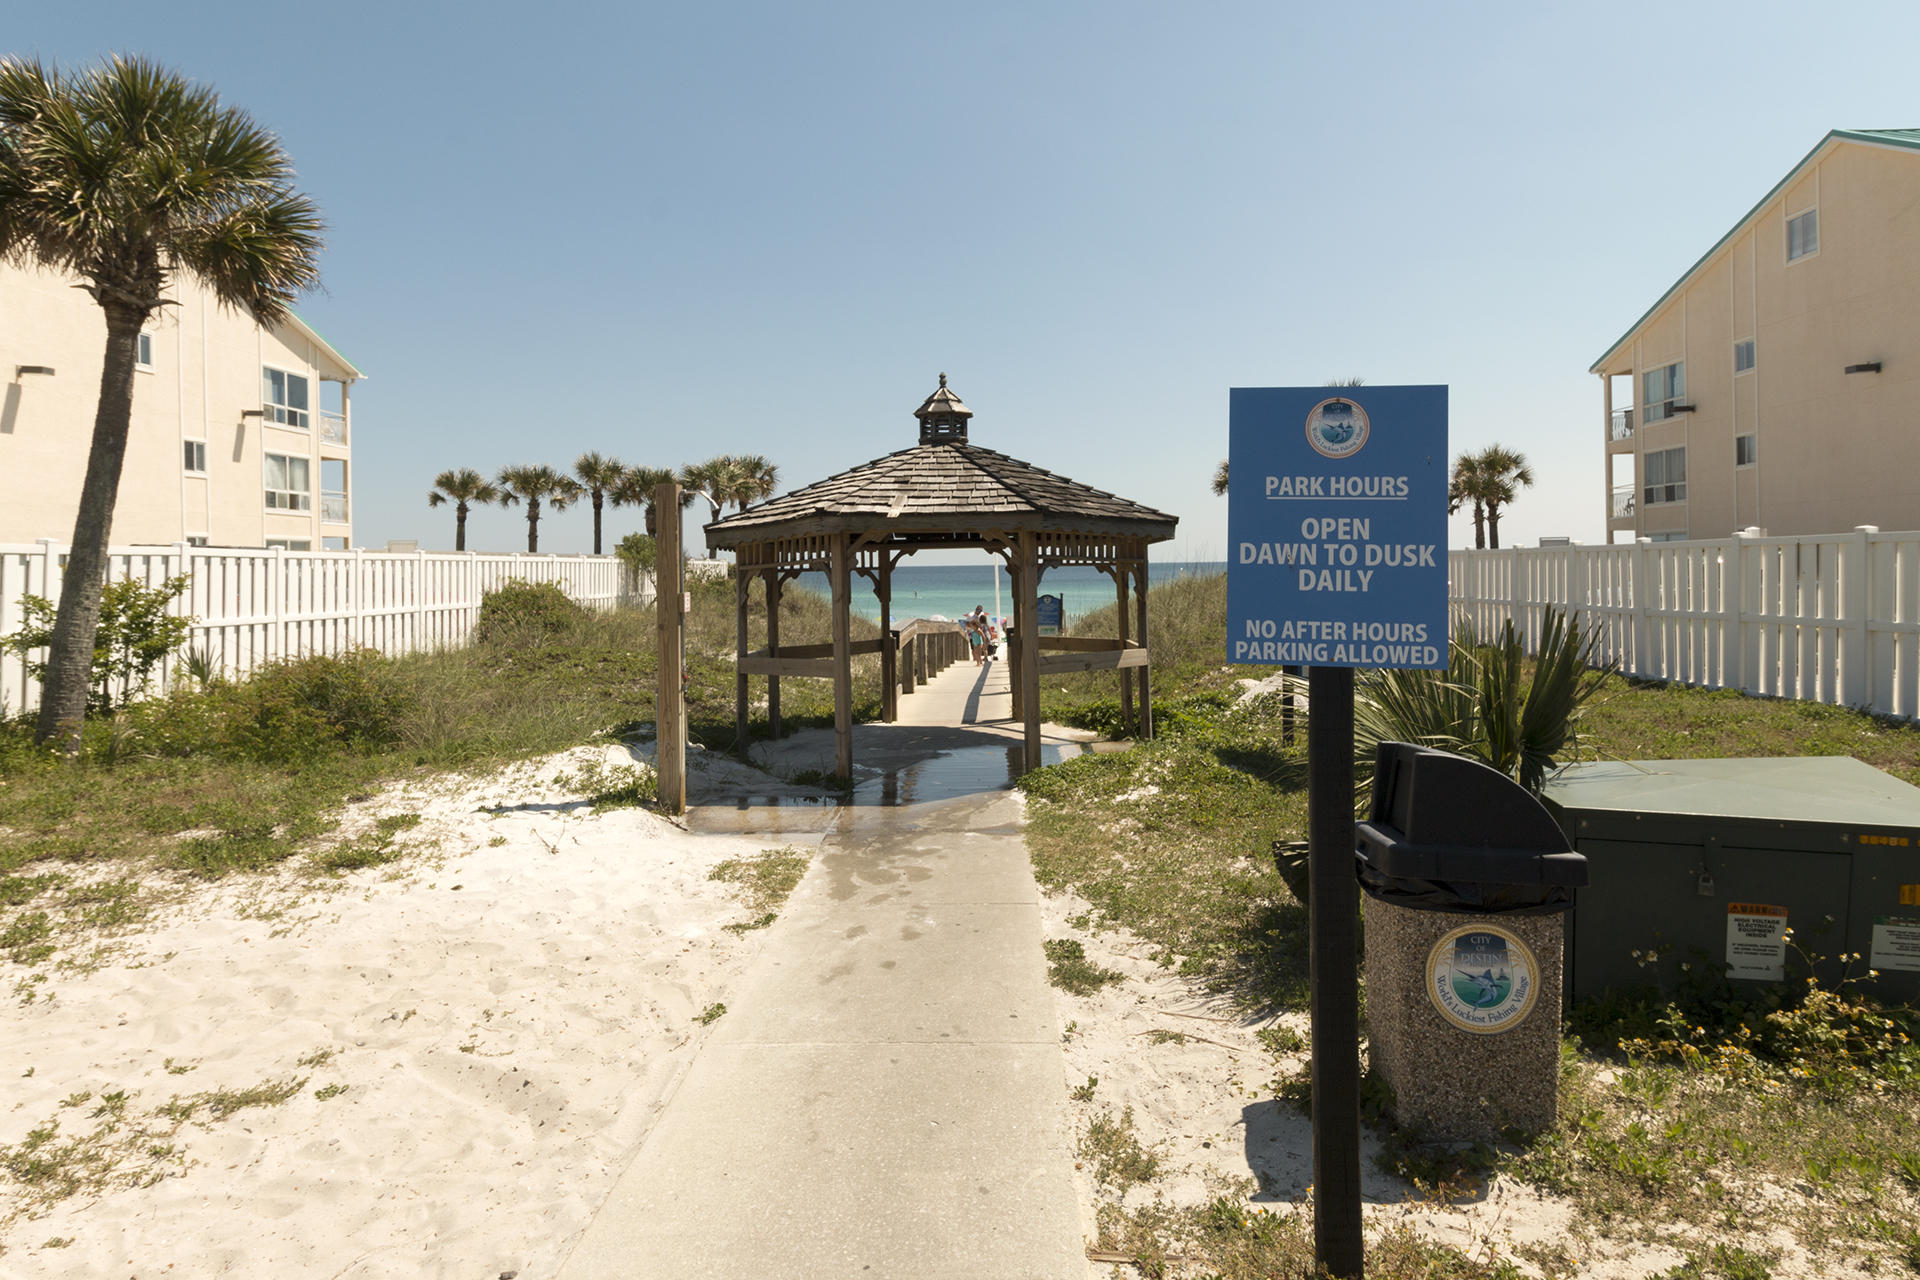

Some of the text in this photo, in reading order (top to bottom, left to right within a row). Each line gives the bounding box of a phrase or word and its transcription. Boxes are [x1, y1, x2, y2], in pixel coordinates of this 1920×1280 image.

[1265, 476, 1409, 496] PARK HOURS
[1301, 518, 1370, 540] OPEN
[1239, 543, 1436, 567] DAWN TO DUSK
[1298, 569, 1374, 592] DAILY
[1246, 620, 1428, 643] NO AFTER HOURS
[1235, 641, 1439, 665] PARKING ALLOWED
[1471, 936, 1491, 944] CITY
[1461, 953, 1502, 963] DESTIN
[1437, 975, 1528, 1023] World's Luckiest Fishing Village
